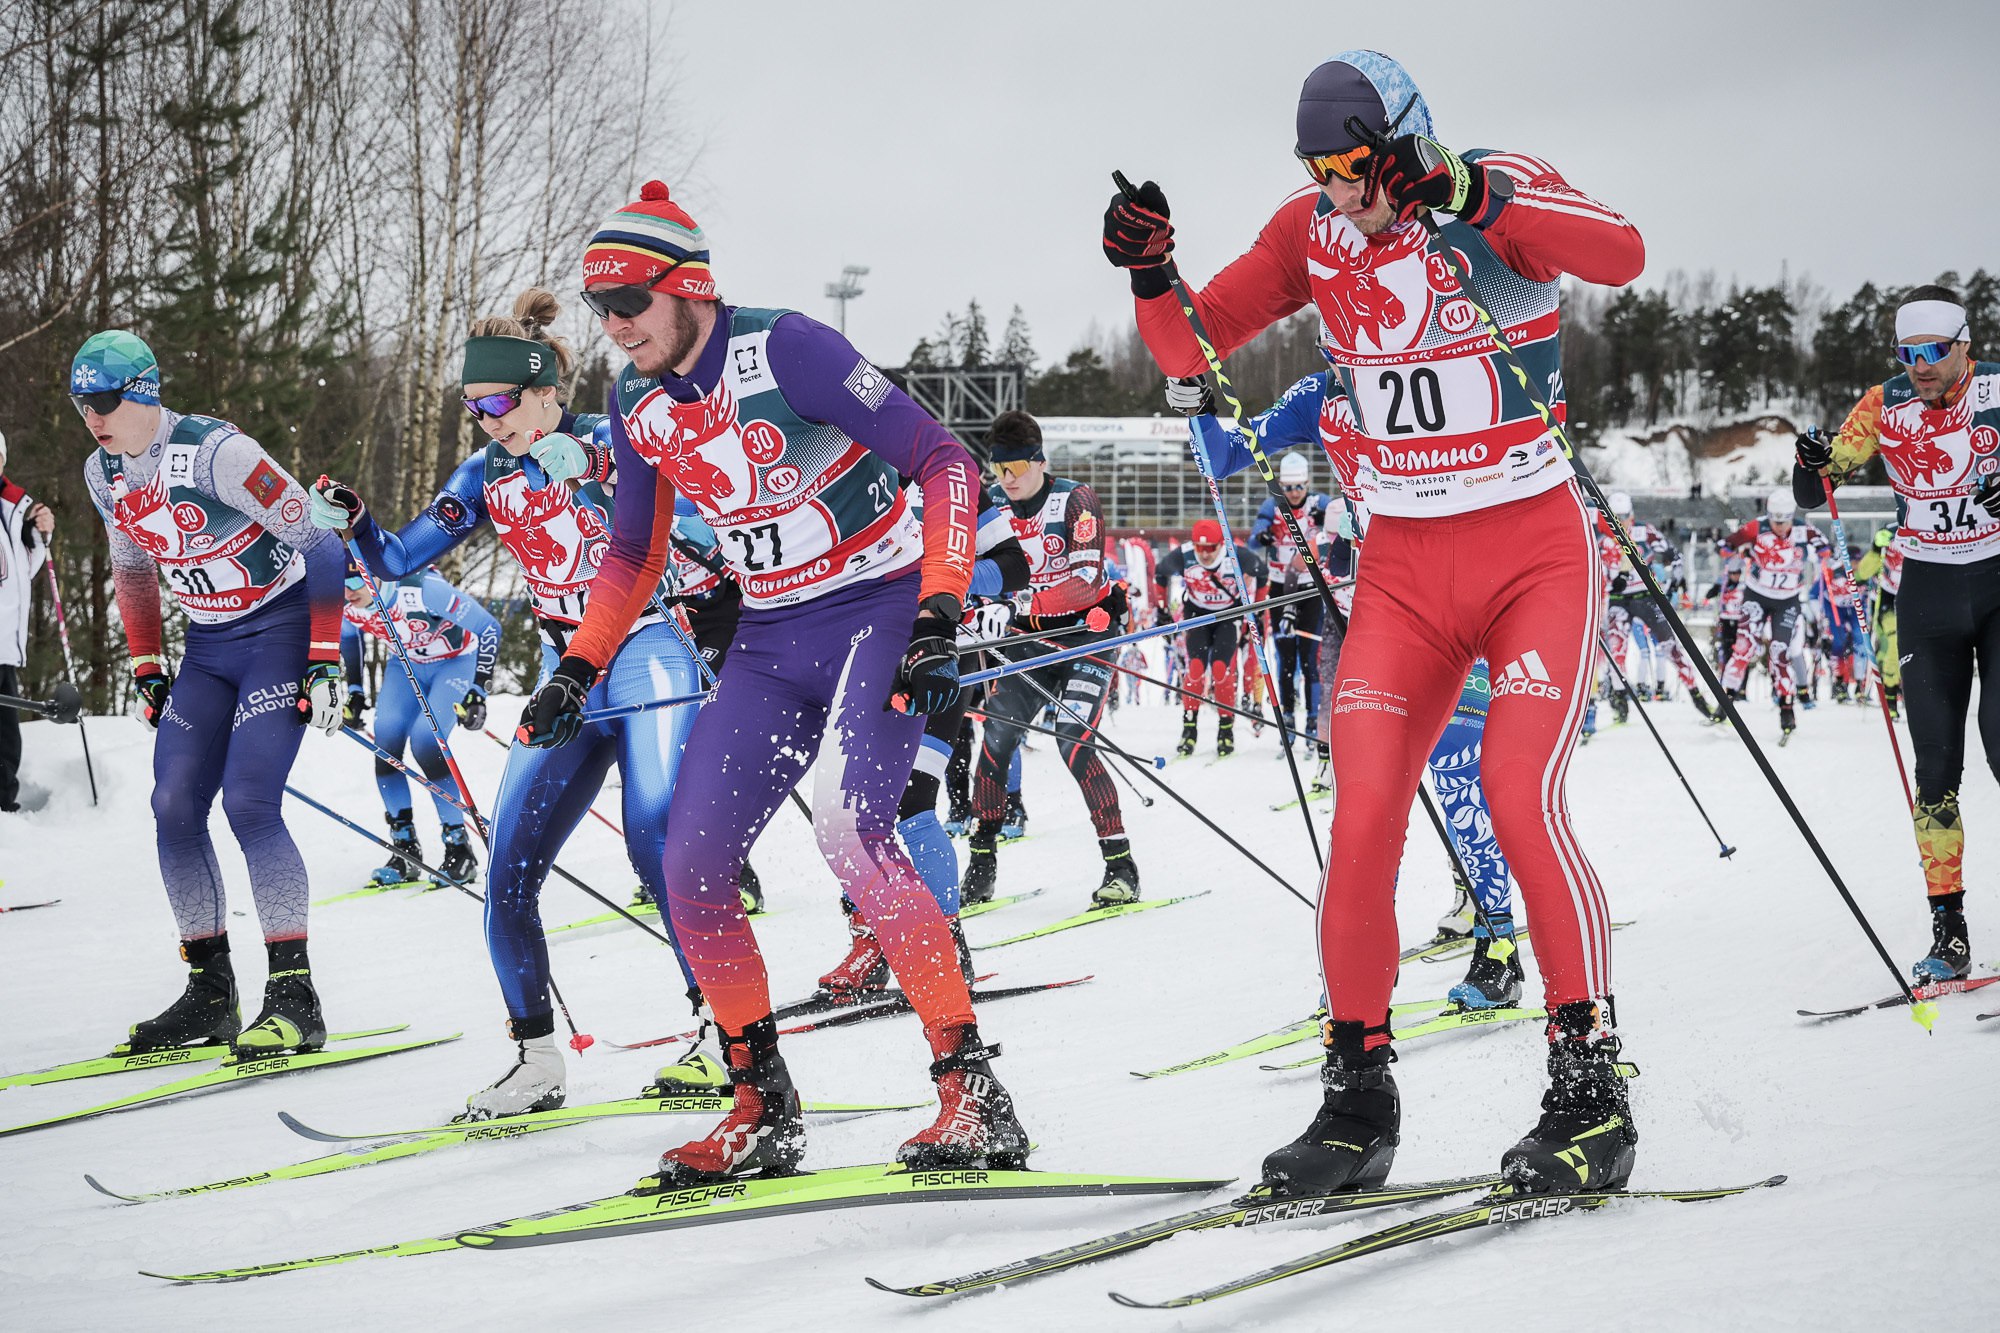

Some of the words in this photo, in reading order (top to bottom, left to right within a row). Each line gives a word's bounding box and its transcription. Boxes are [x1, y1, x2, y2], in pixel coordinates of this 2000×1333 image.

[1445, 304, 1471, 327] КЛ
[740, 373, 762, 385] Ростех
[1379, 367, 1446, 435] 20
[748, 426, 775, 450] 30
[1975, 429, 1993, 448] 30
[761, 451, 774, 461] КМ
[1377, 442, 1488, 471] Демино
[1982, 461, 1995, 473] КЛ
[772, 470, 796, 490] КЛ
[868, 472, 895, 514] 27
[177, 507, 198, 526] 30
[1930, 498, 1978, 533] 34
[727, 522, 783, 572] 27
[1046, 539, 1060, 551] 30
[537, 582, 569, 598] Demino
[1771, 574, 1788, 590] 12
[248, 681, 298, 705] CLUB
[1383, 702, 1408, 717] team
[1461, 1010, 1496, 1024] FISCHER
[124, 1050, 191, 1068] FISCHER
[236, 1058, 290, 1076] FISCHER
[659, 1098, 722, 1111] FISCHER
[464, 1123, 529, 1142] FISCHER
[912, 1171, 989, 1187] FISCHER
[655, 1183, 747, 1209] FISCHER
[1241, 1199, 1325, 1227] FISCHER
[1487, 1197, 1571, 1225] FISCHER
